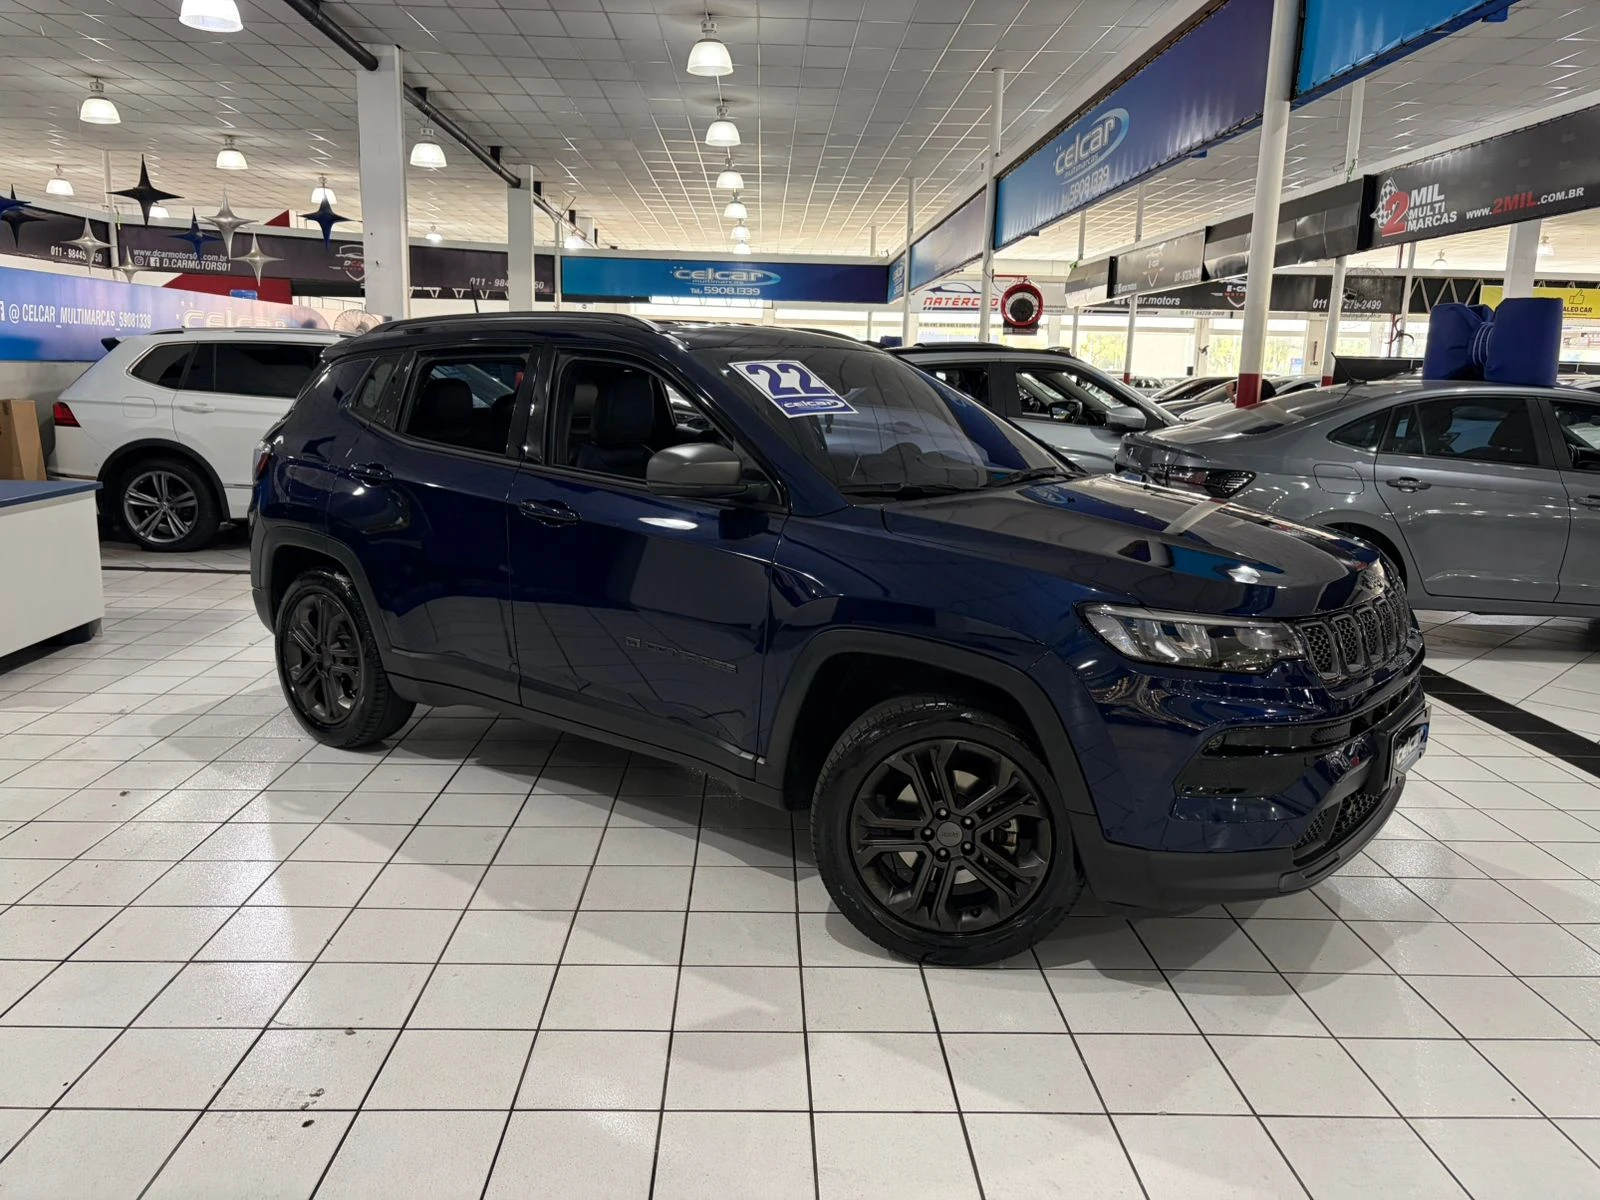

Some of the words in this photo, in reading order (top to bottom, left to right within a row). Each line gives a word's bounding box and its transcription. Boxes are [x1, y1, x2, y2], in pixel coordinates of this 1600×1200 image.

[1055, 116, 1116, 176] celcar
[1382, 191, 1410, 237] 2
[1410, 183, 1445, 208] MIL
[1408, 201, 1446, 220] MULTI
[1407, 211, 1458, 233] MARCAS
[673, 267, 764, 281] celcar
[704, 286, 761, 296] 5908.1339
[745, 363, 832, 396] 22
[783, 400, 834, 409] celcar
